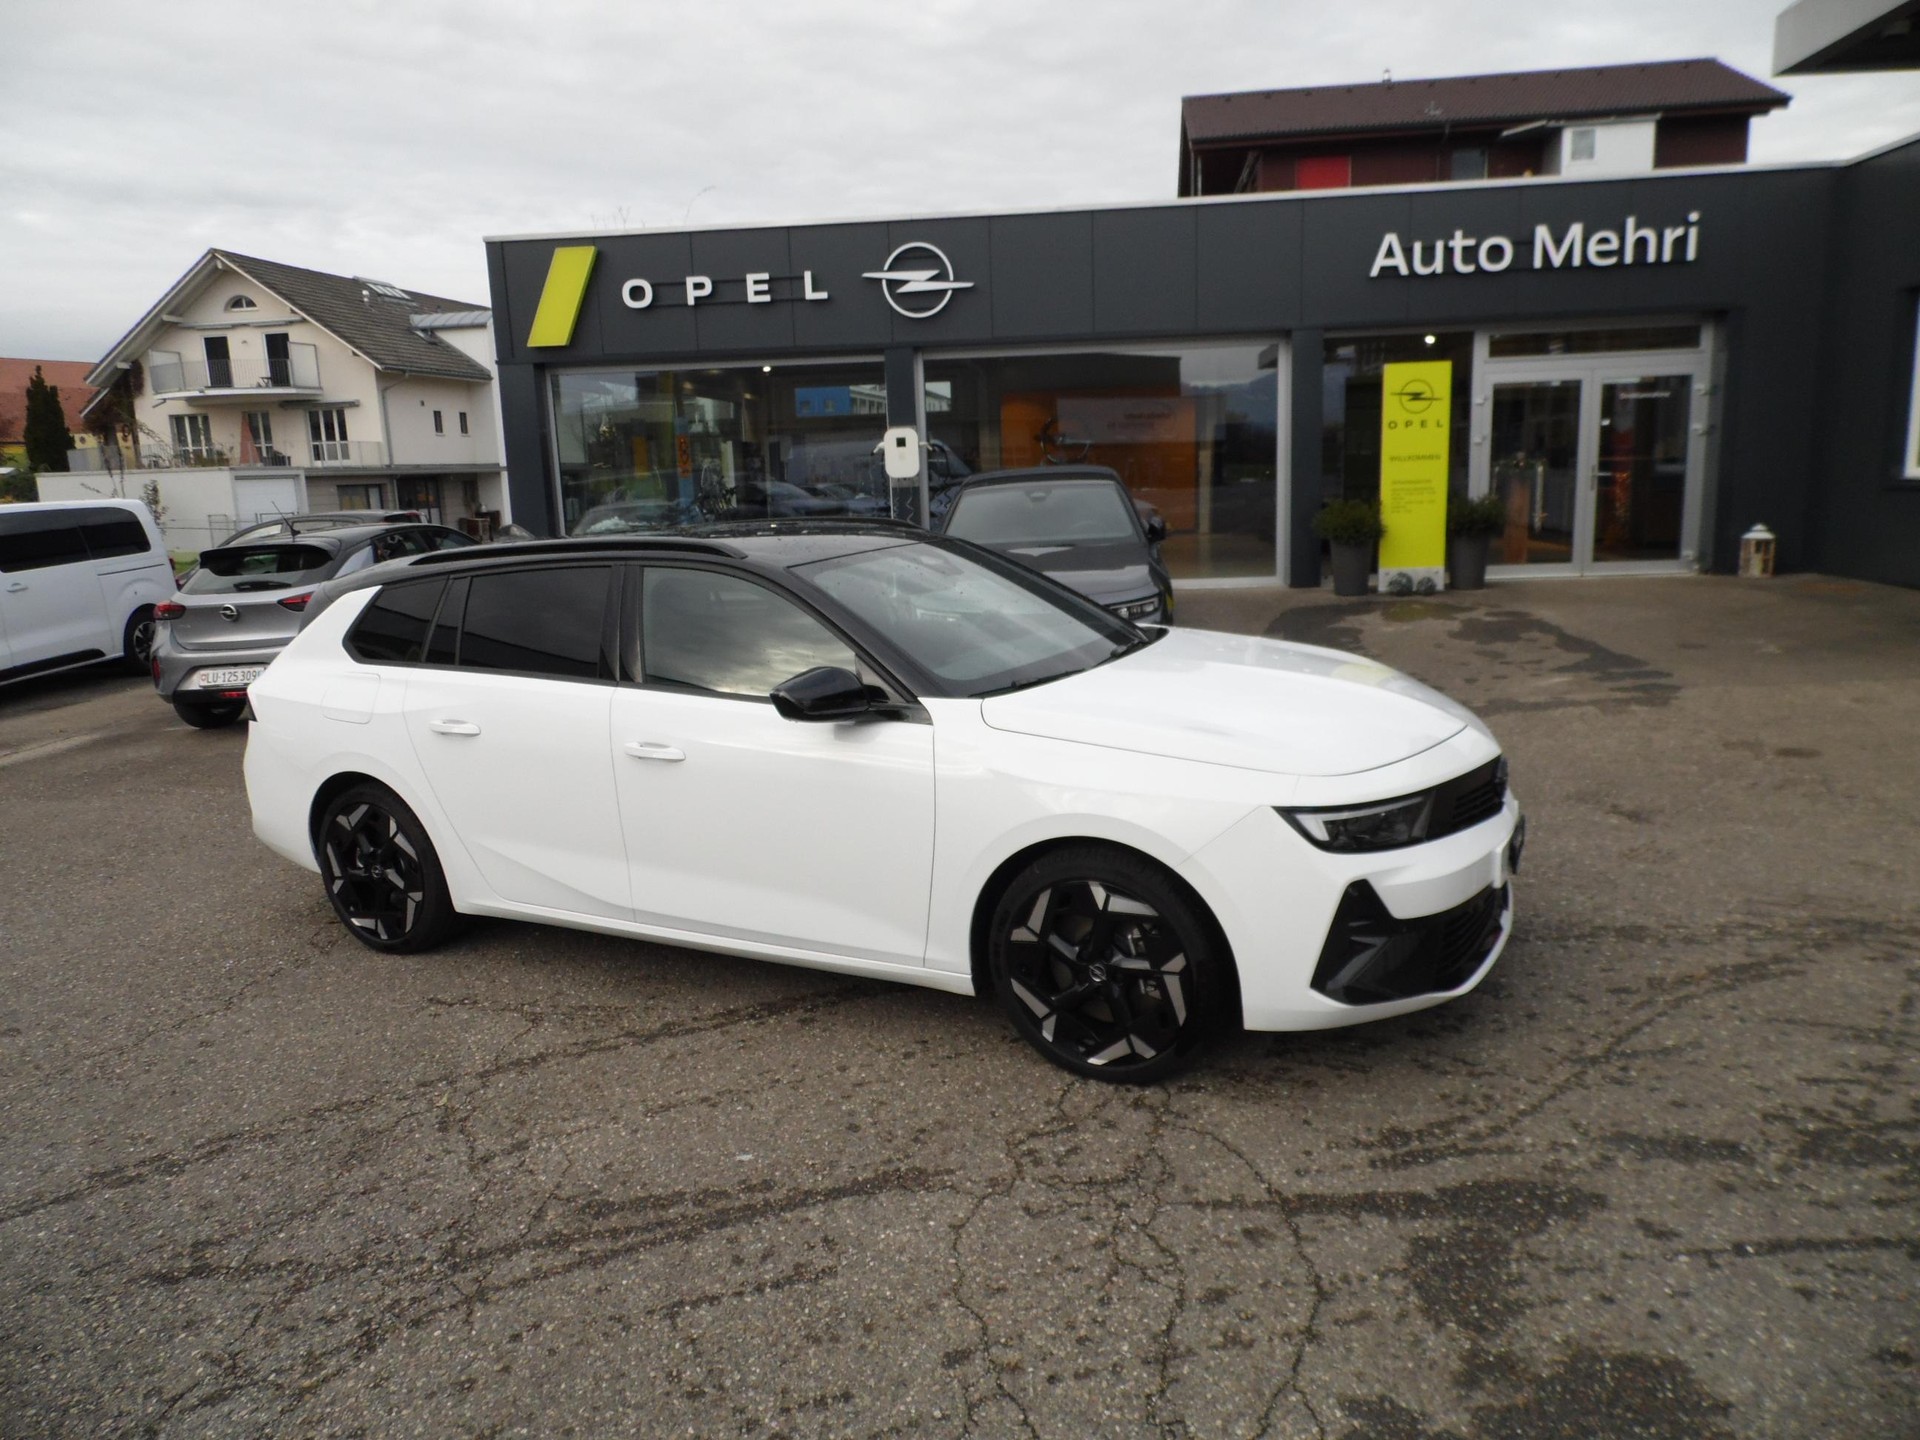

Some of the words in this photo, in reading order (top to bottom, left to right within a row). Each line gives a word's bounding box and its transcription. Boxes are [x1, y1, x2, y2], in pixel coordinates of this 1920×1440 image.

[1369, 229, 1514, 278] Auto
[1533, 210, 1701, 269] Mehri
[621, 270, 829, 309] OPEL
[1388, 419, 1444, 430] OPEL
